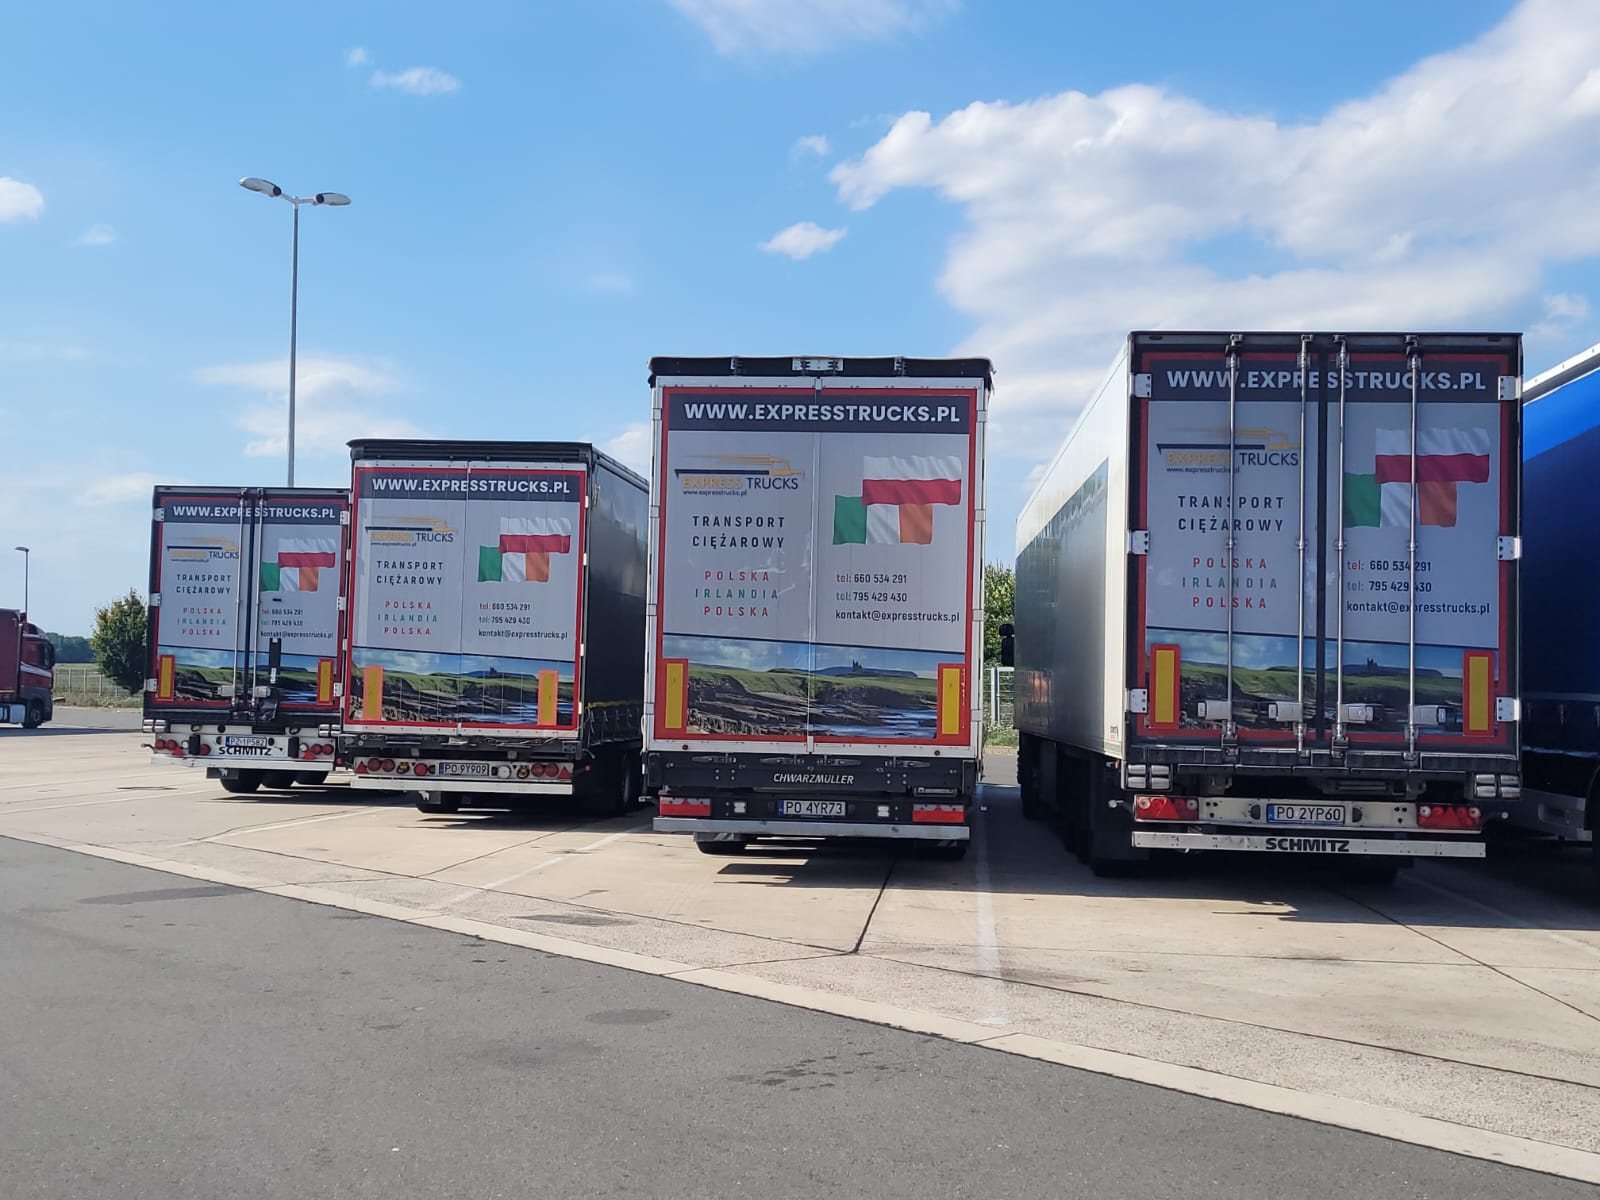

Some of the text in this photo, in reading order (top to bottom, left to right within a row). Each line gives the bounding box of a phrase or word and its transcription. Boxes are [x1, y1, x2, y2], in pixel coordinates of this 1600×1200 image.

[1167, 370, 1486, 390] WWW.EXPRESSTRUCKS.PL
[684, 403, 960, 423] WWW.EXPRESSTRUCKS.PL
[1239, 452, 1299, 466] TRUCKS
[372, 478, 571, 494] WWW.EXPRESSTRUCKS.PL
[746, 477, 799, 490] TRUCKS
[692, 515, 785, 528] TRANSPORT
[1178, 515, 1283, 533] CIĘŻAROWY
[416, 532, 454, 543] TRUCKS
[692, 533, 784, 549] CIĘŻAROWY
[208, 551, 239, 559] TRUCKS
[376, 560, 444, 570] TRANSPORT
[1193, 557, 1267, 568] POLSKA
[1347, 560, 1431, 572] tel: 660 534 291
[376, 574, 443, 586] CIĘŻAROWY
[704, 570, 769, 581] POLSKA
[836, 573, 907, 584] tel: 660 534 291
[1182, 577, 1278, 589] IRLANDIA
[1347, 581, 1364, 591] tel:
[1369, 581, 1387, 591] 795
[1391, 581, 1409, 592] 429
[695, 588, 778, 599] IRLANDIA
[836, 592, 907, 602] tel: 795 429 430
[385, 601, 431, 609] POLSKA
[506, 603, 518, 611] 534
[519, 603, 530, 611] 291
[1192, 596, 1267, 608] POLSKA
[704, 606, 768, 617] POLSKA
[835, 610, 960, 623] kontakt@expresstrucks.pl
[377, 614, 437, 622] IRLANDIA
[491, 616, 503, 624] 795
[384, 626, 431, 635] POLSKA
[479, 629, 568, 640] kontakt@expresstrucks.pl
[219, 746, 272, 756] SCHMITZ
[786, 801, 843, 814] PO 4YR73
[1277, 806, 1341, 821] PO 2YP60
[1265, 837, 1350, 852] SCHMITZ
